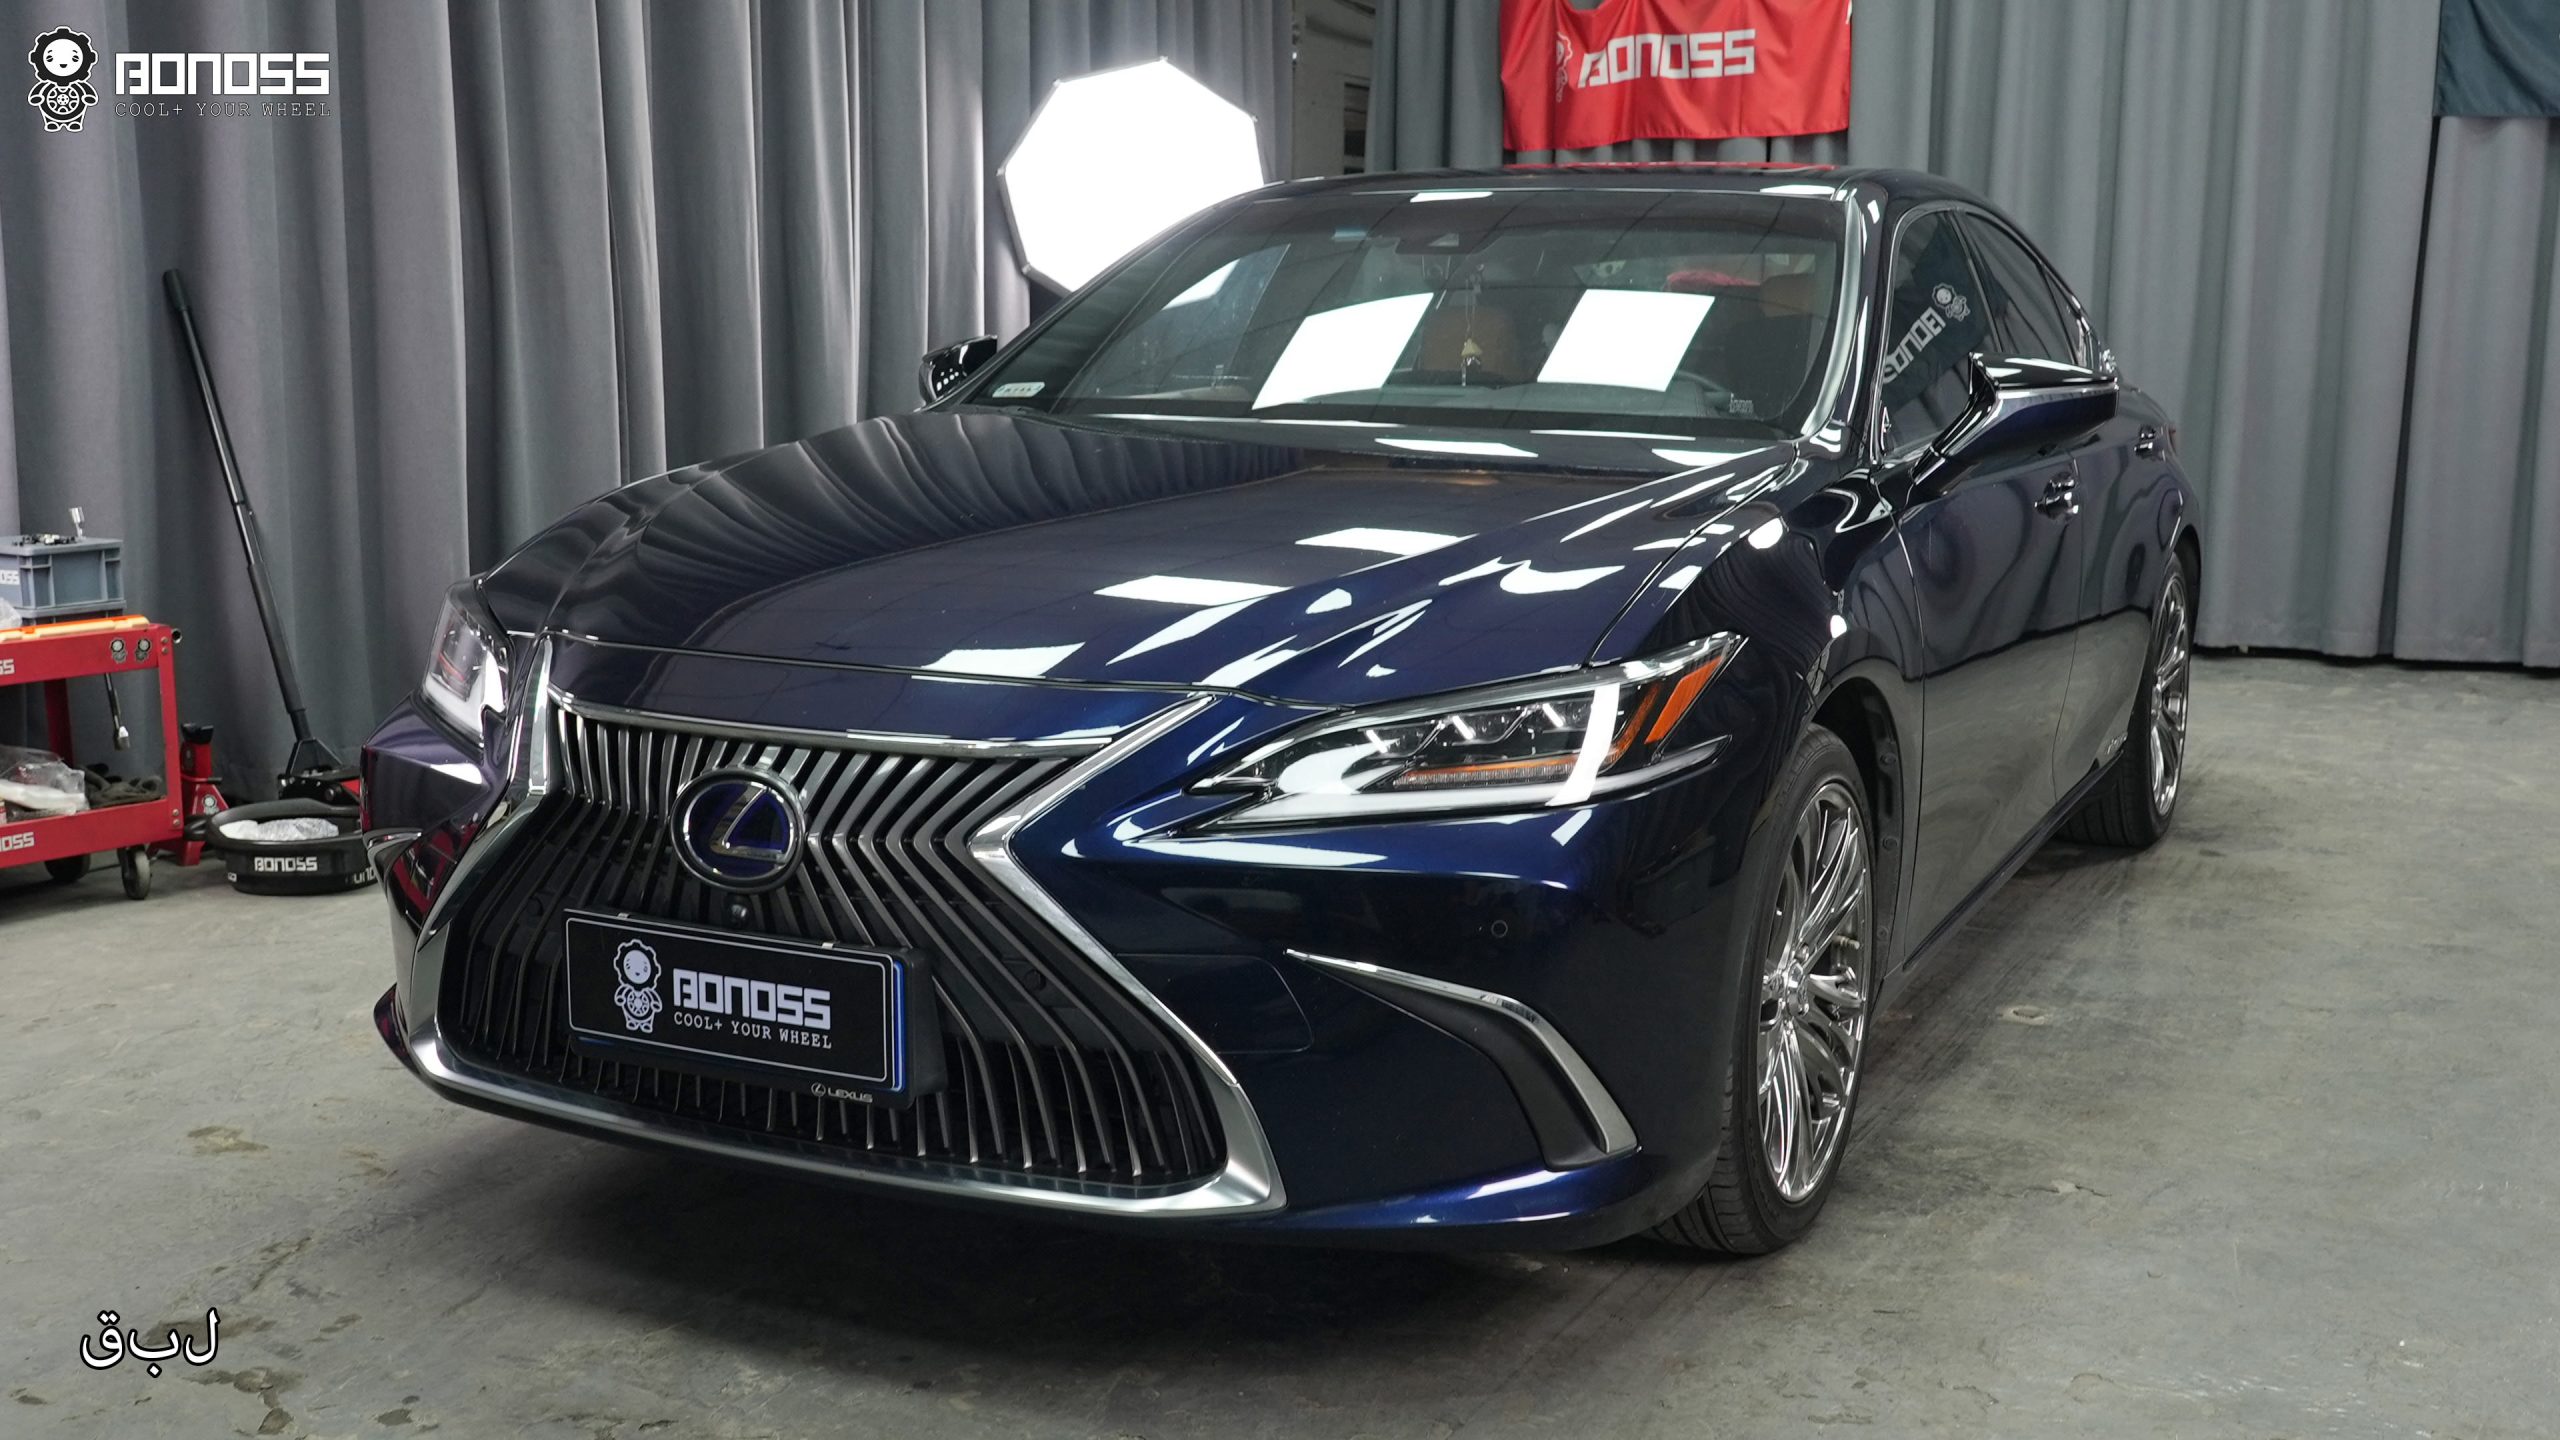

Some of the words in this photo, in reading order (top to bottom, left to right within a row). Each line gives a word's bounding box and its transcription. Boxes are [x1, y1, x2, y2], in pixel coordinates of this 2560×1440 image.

[1578, 29, 1756, 88] BONOSS
[0, 831, 35, 852] OSS
[254, 856, 318, 872] BONOSS
[673, 968, 831, 1030] BONOSS
[674, 1011, 722, 1030] COOL+
[731, 1020, 772, 1040] YOUR
[779, 1028, 832, 1049] WHEEL
[828, 1087, 873, 1103] LEXUS
